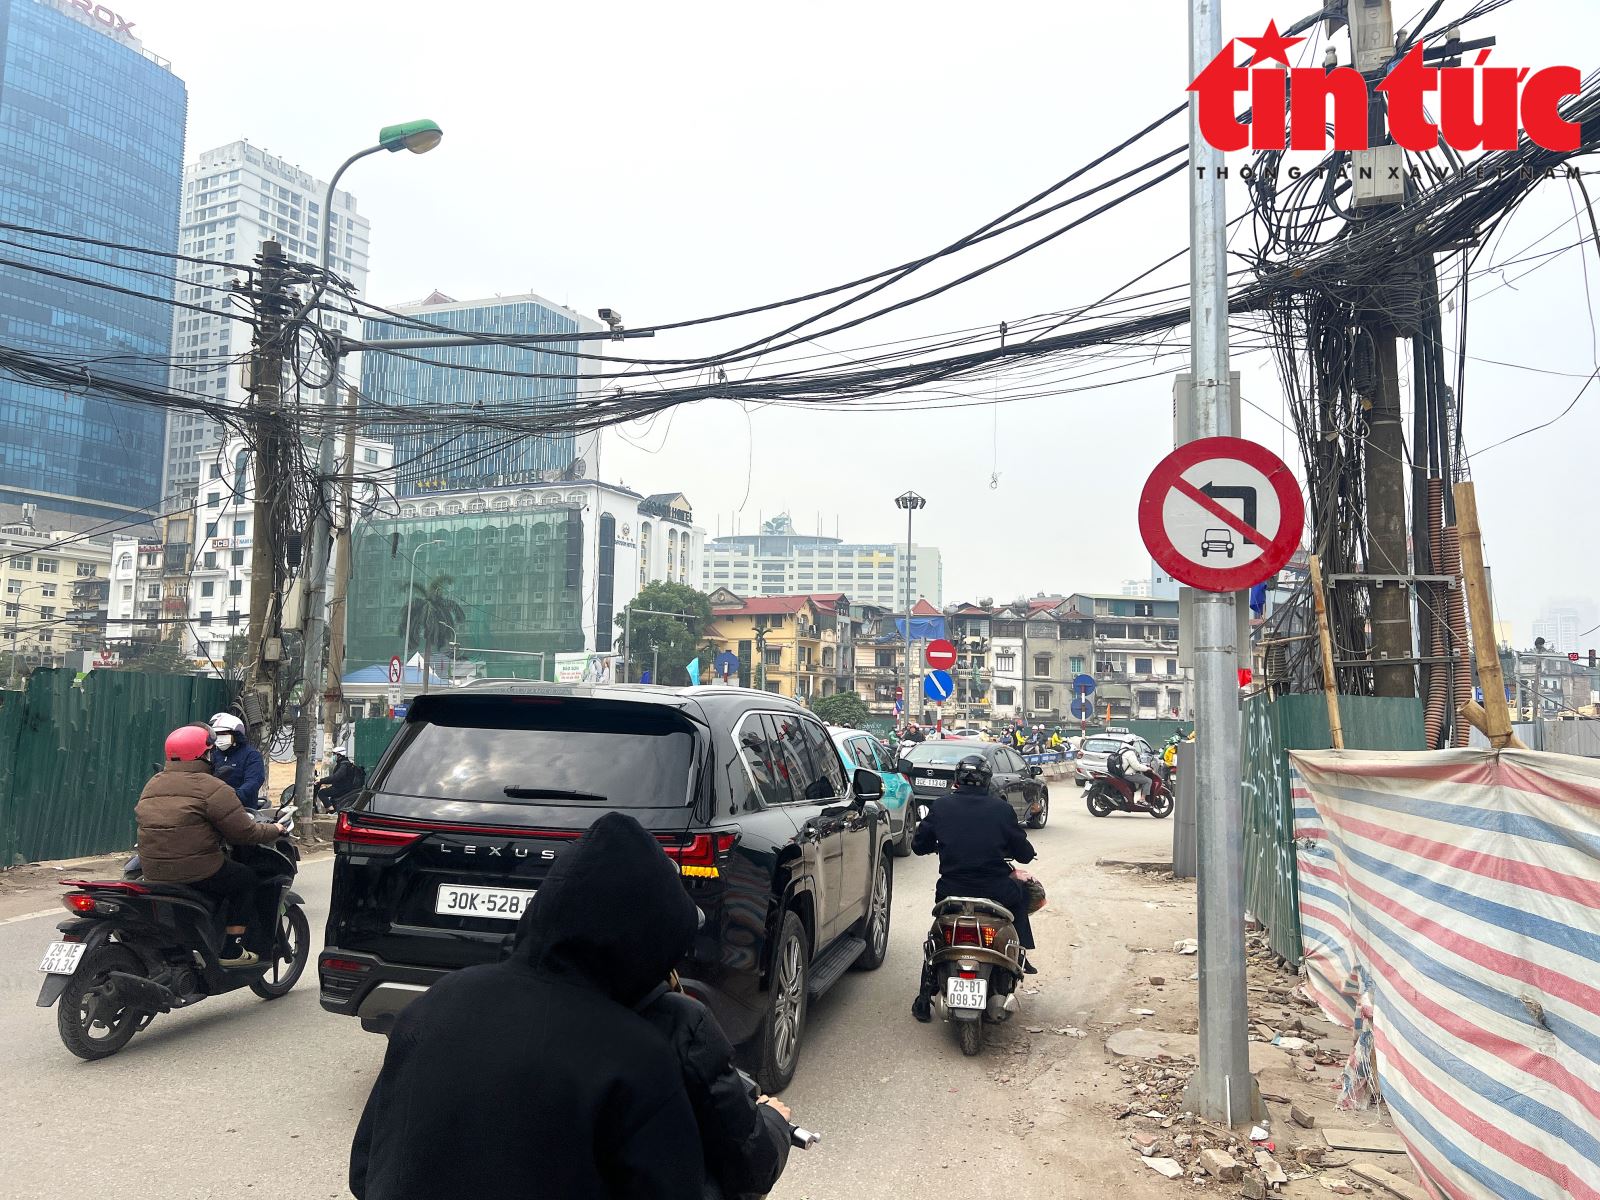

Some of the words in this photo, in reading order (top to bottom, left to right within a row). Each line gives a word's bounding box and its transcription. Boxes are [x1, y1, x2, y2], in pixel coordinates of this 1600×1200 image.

[671, 507, 692, 522] HOTEL
[212, 539, 229, 548] JCB
[440, 843, 555, 860] LEXUS
[50, 943, 80, 958] 29-AE
[40, 957, 75, 972] 261.34
[953, 980, 981, 994] 29-B1
[949, 993, 983, 1007] 098.57
